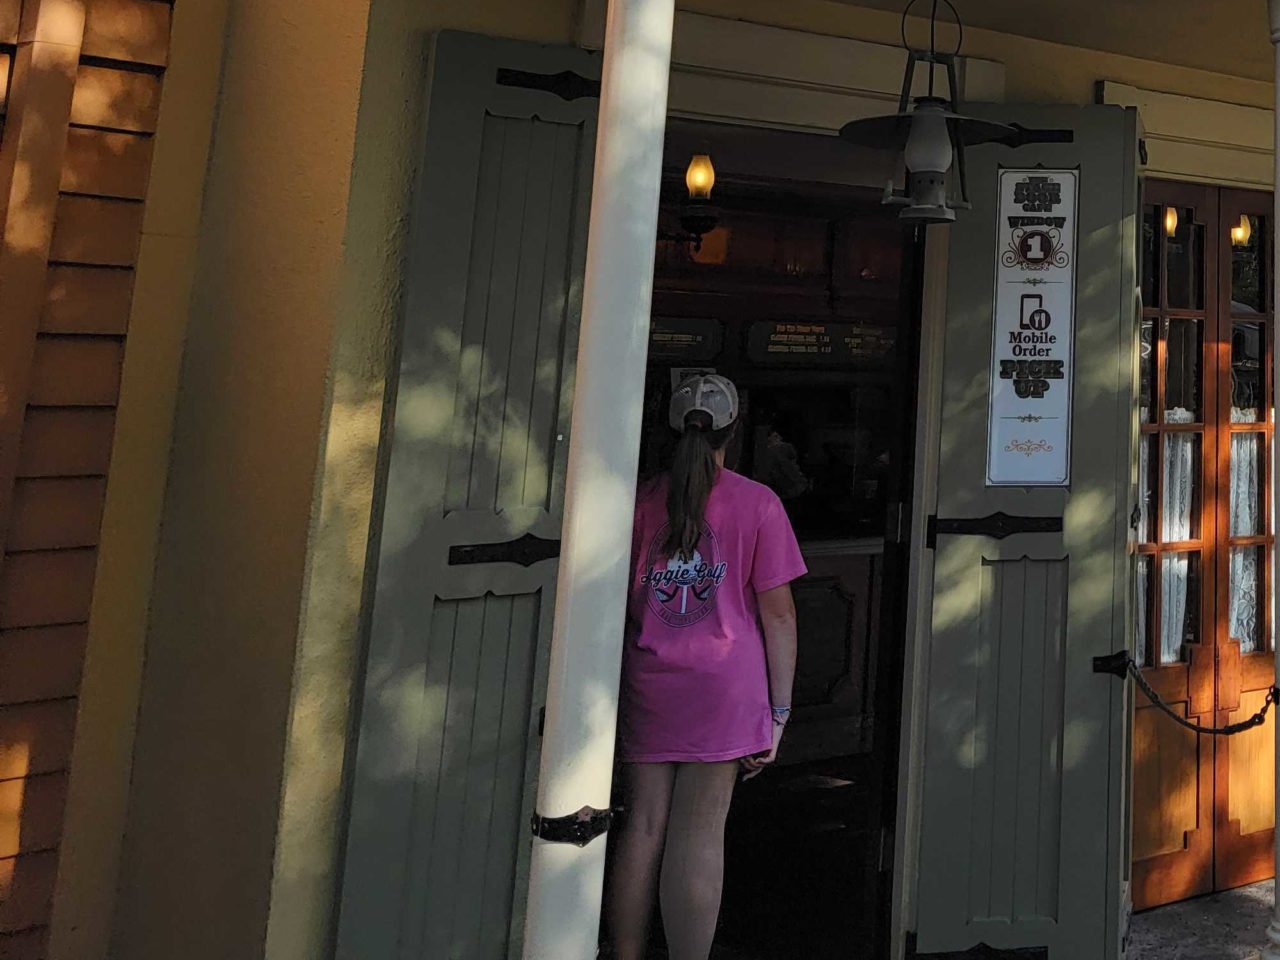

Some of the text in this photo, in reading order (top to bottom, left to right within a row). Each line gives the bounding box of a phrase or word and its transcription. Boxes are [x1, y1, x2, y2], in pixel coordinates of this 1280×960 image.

[1007, 216, 1067, 228] WINDOW
[1025, 235, 1045, 259] 1
[1008, 331, 1057, 345] Mobile
[1012, 344, 1052, 357] Order
[1000, 359, 1064, 379] PICK
[1013, 379, 1050, 399] UP
[640, 561, 728, 589] Aggie Golf
